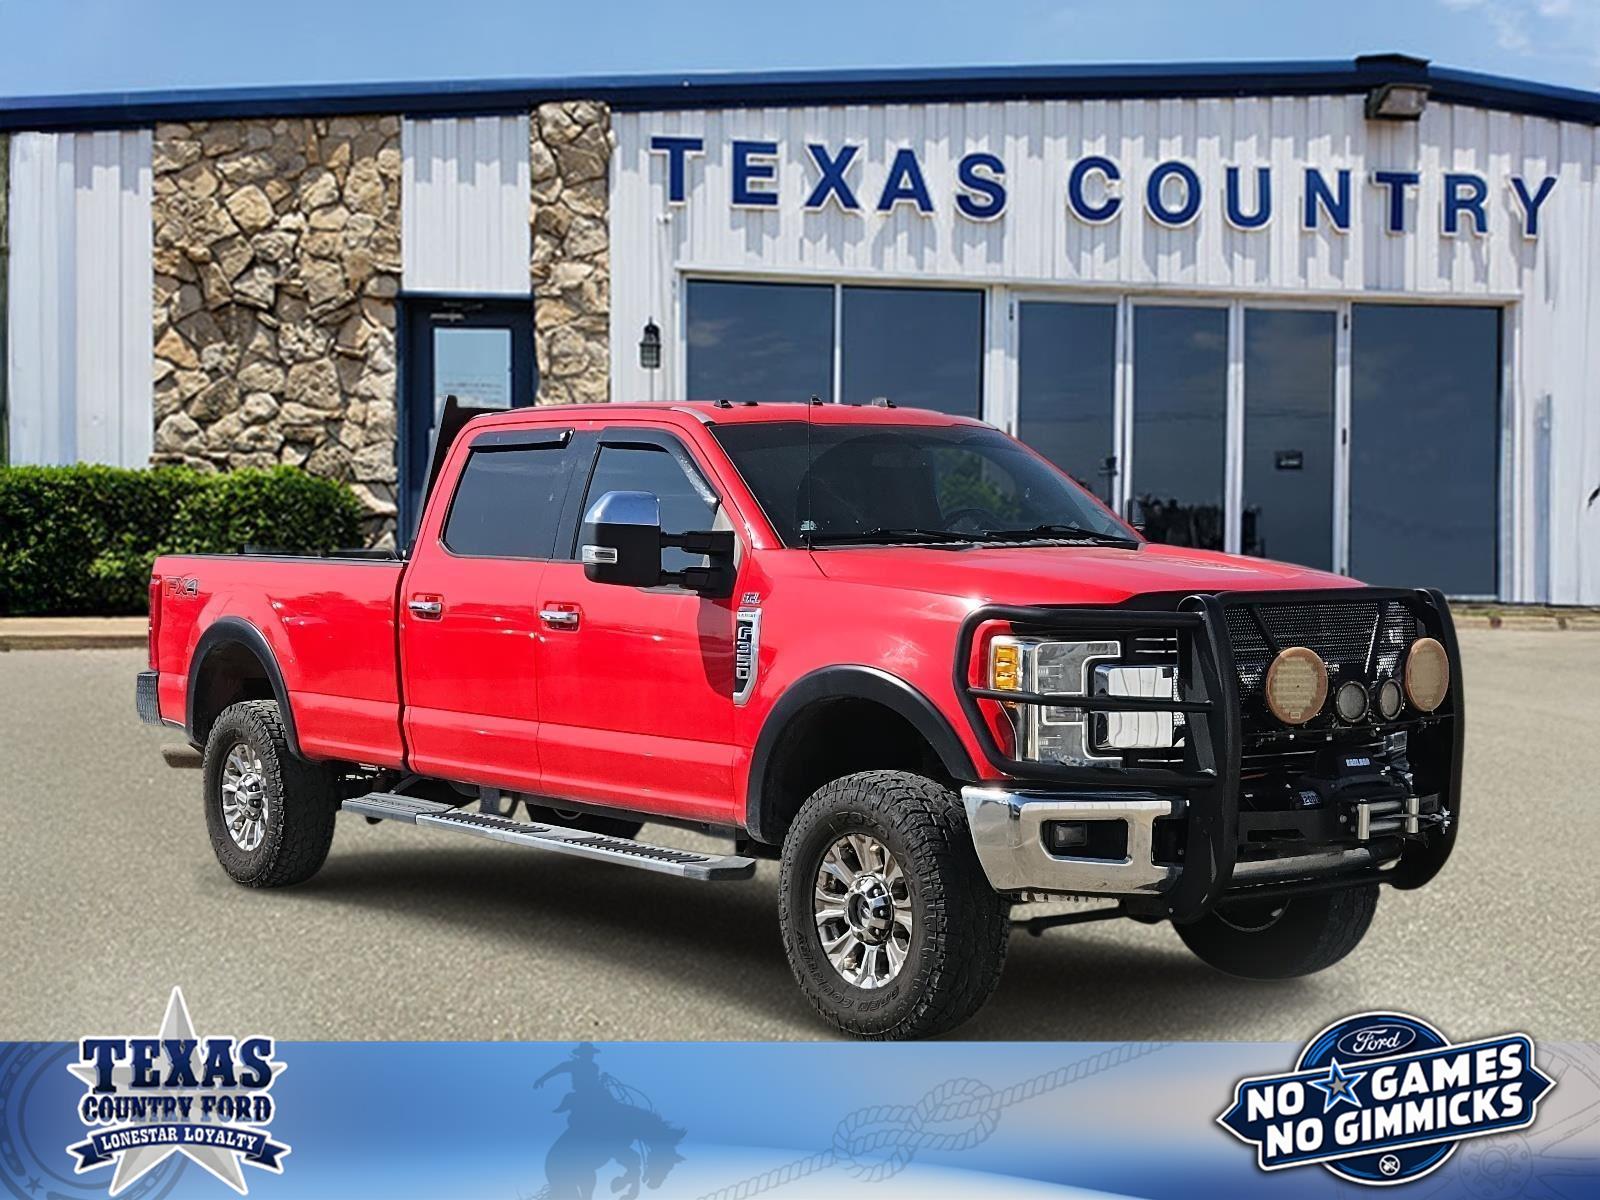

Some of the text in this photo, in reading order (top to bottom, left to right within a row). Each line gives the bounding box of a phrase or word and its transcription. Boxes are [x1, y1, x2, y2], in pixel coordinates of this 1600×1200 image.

[650, 136, 1556, 239] TEXAS COUNTRY
[163, 576, 199, 597] FX4
